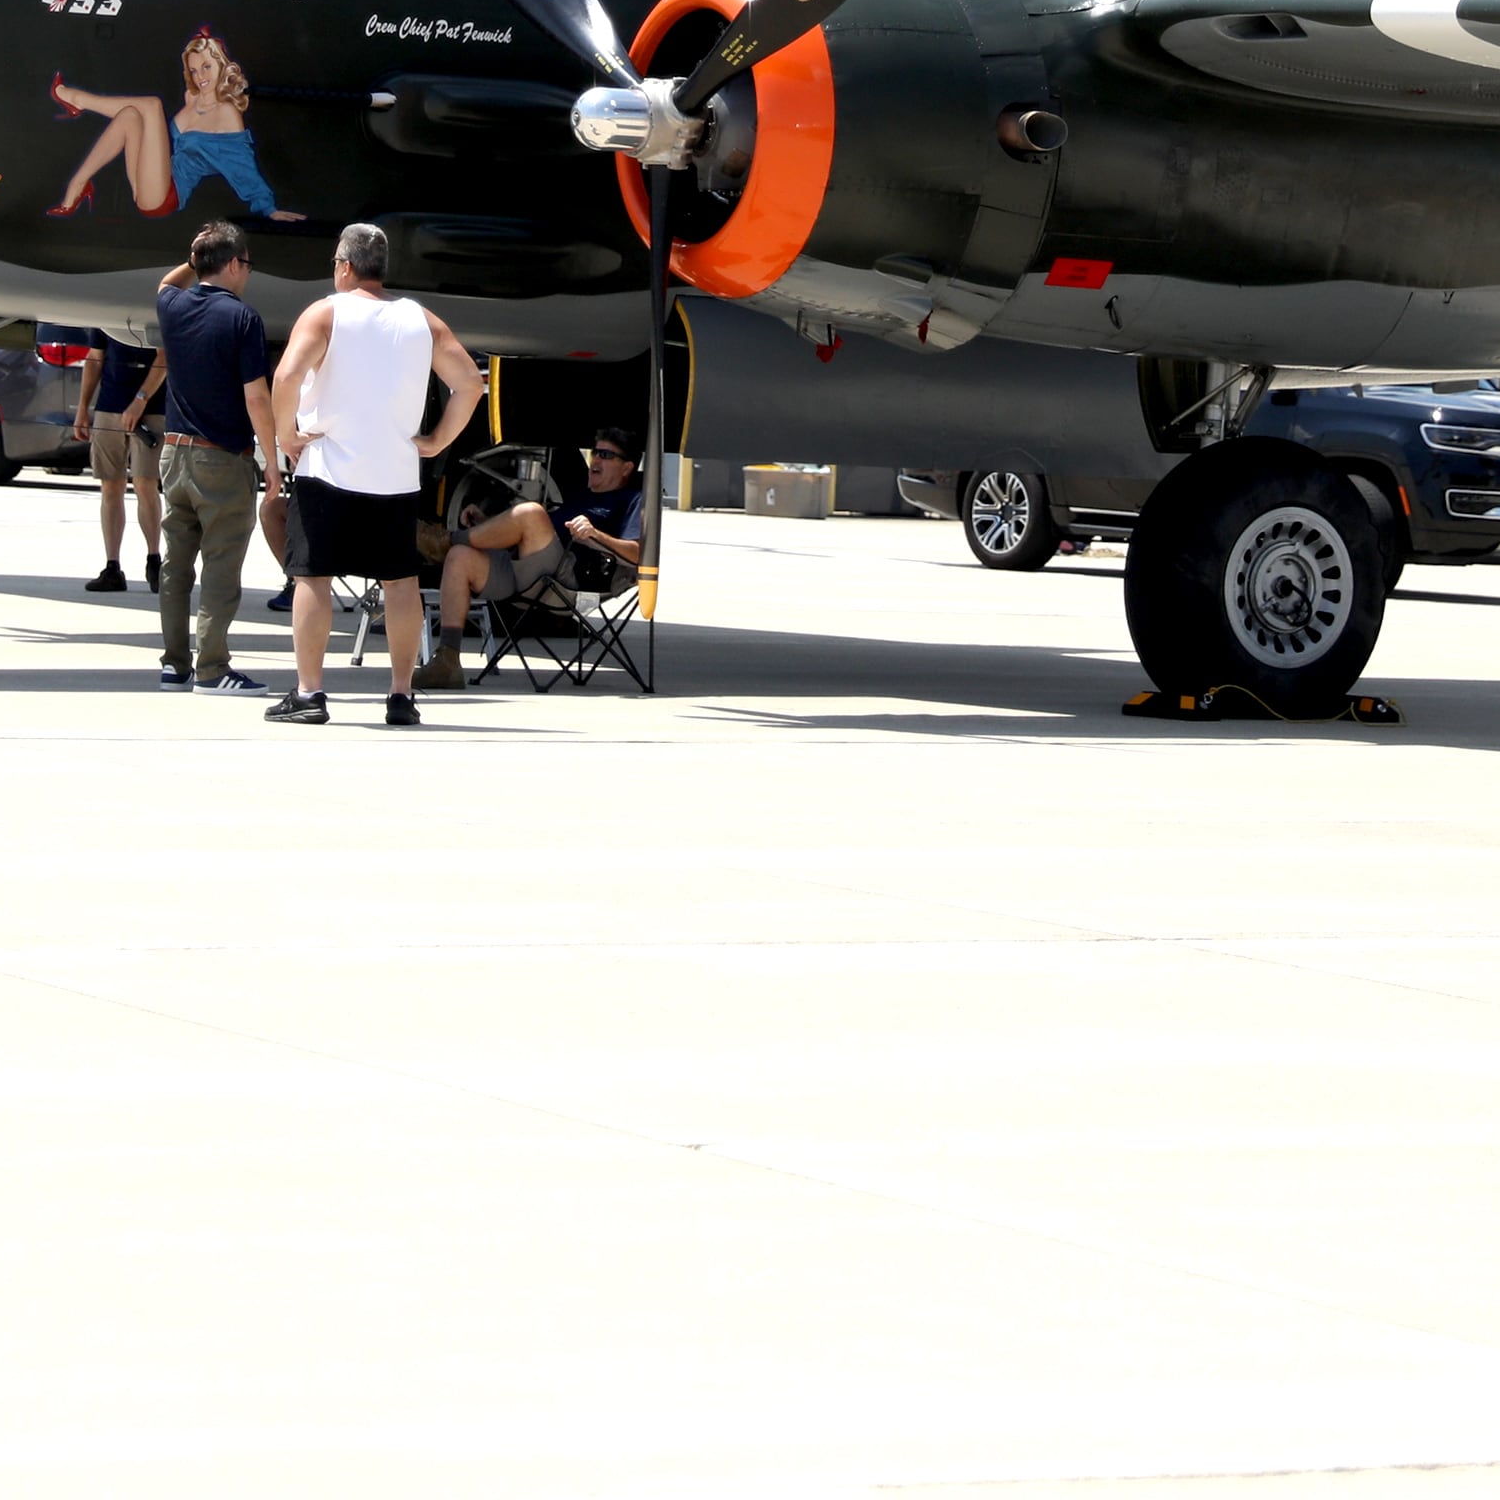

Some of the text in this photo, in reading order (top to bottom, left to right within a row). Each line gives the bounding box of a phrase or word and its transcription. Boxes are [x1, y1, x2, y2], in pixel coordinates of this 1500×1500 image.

[365, 14, 513, 43] Crew Chief Pat Fenwick
